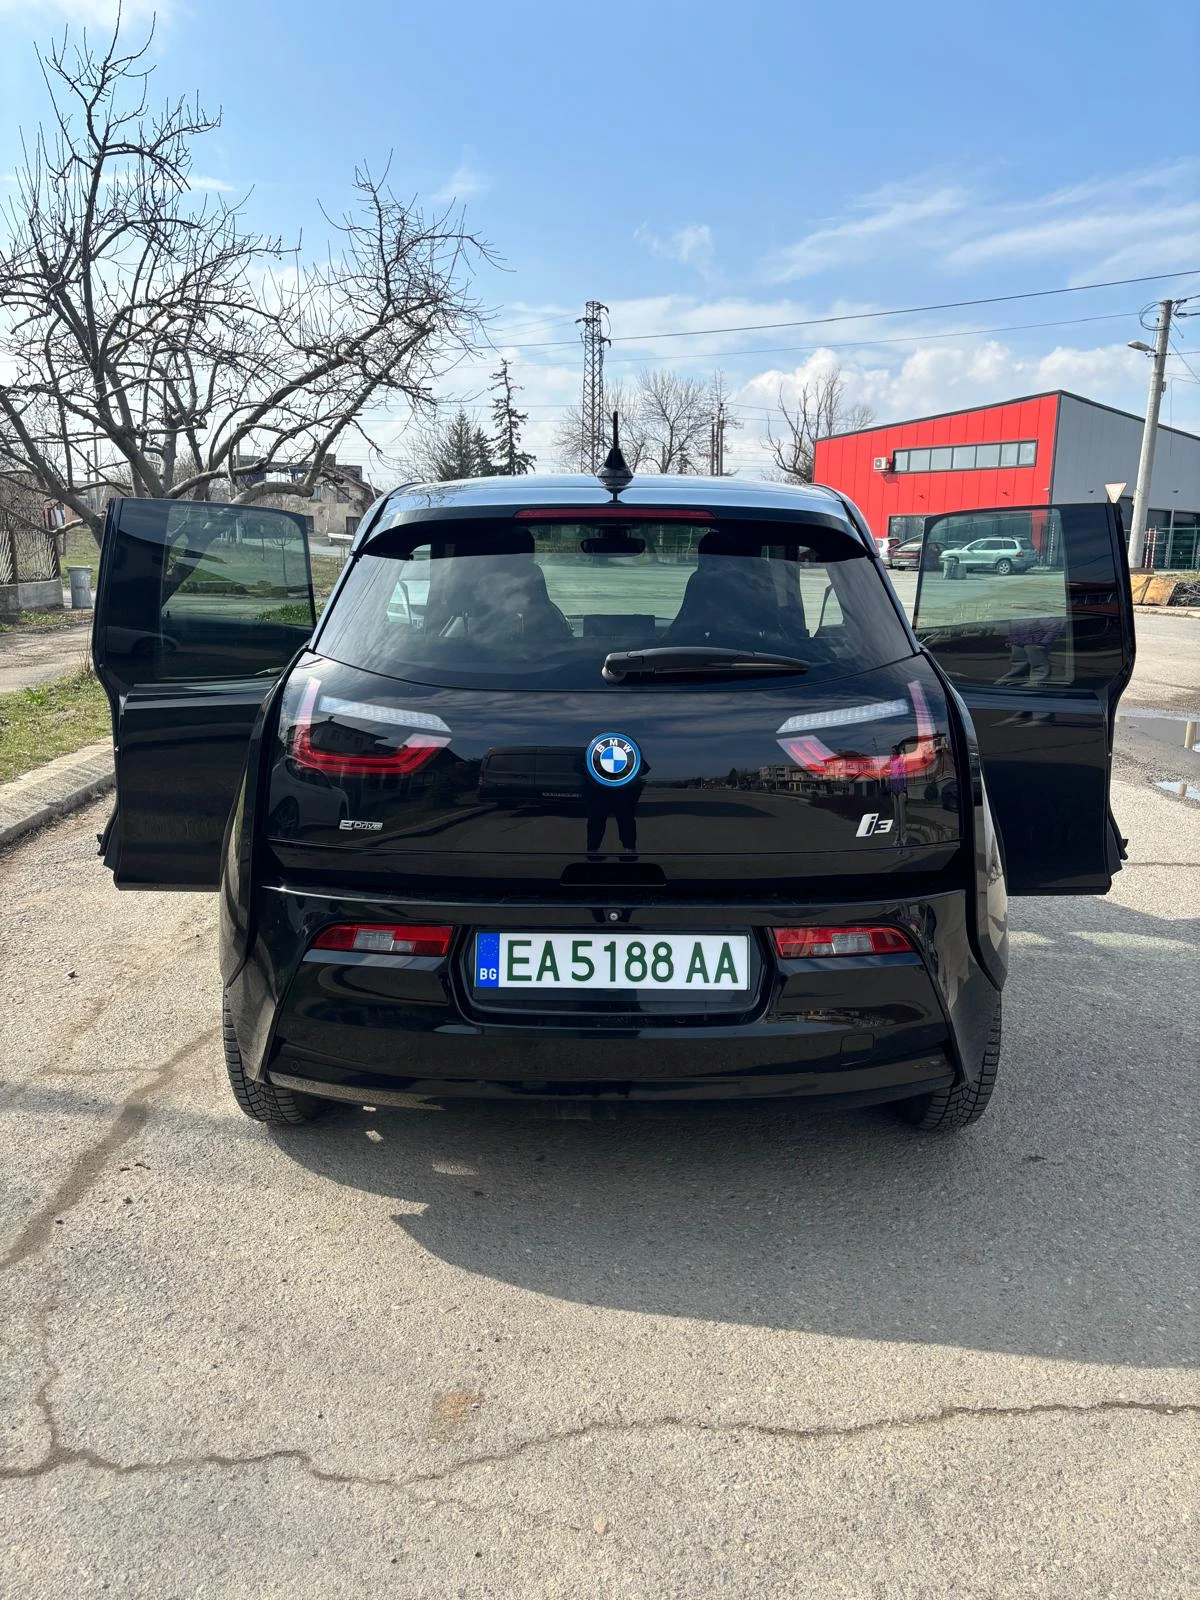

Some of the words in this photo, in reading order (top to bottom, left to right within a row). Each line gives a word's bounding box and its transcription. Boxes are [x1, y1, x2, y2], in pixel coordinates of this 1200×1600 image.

[596, 739, 632, 753] BMW
[856, 813, 893, 837] i3
[506, 940, 560, 982] EA
[571, 940, 675, 983] 5188
[685, 941, 739, 983] AA
[479, 967, 497, 980] BG
